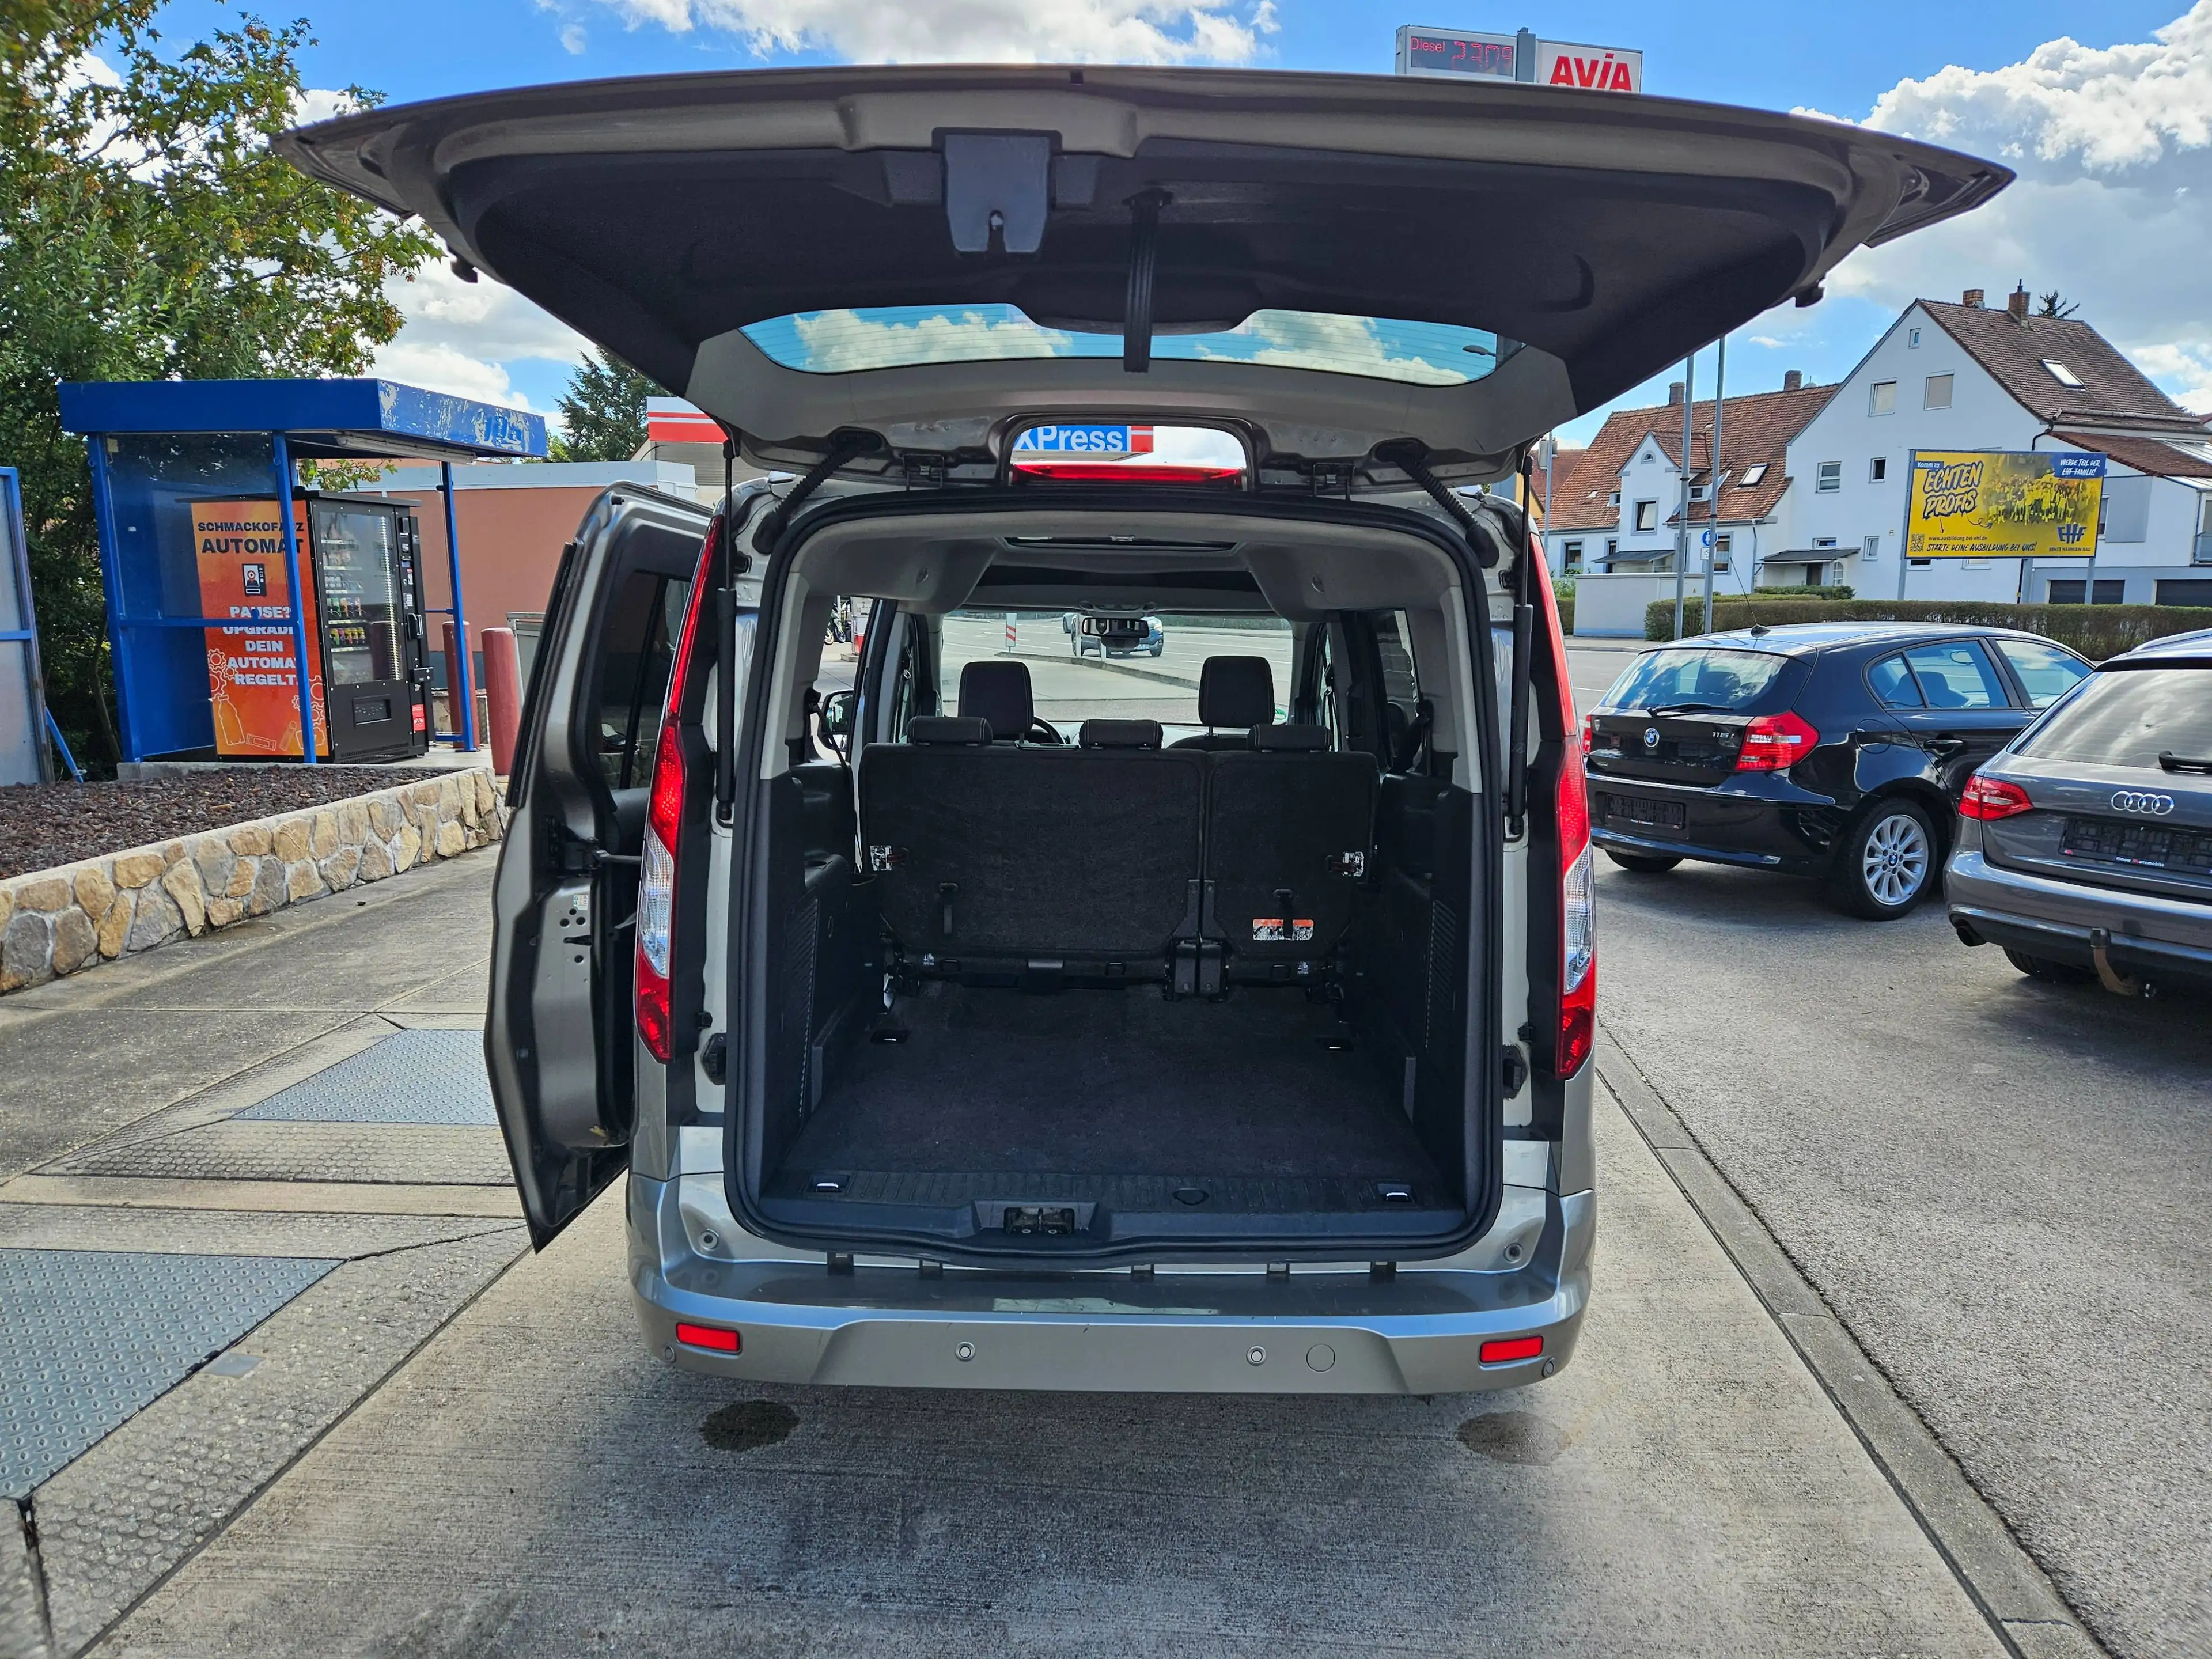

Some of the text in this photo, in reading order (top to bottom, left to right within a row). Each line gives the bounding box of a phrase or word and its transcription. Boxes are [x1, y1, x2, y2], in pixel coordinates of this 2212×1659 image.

[1411, 37, 1445, 52] Diesel
[2078, 459, 2089, 467] TEIL
[1923, 460, 1984, 494] ECHTEN
[1923, 488, 1978, 520] PROFIS
[198, 522, 304, 532] SCHMACKOFZ
[2057, 524, 2088, 544] EHF
[1927, 543, 1949, 551] STARTE
[1969, 543, 2009, 551] AUSBILDUNG
[2010, 543, 2020, 551] BEI
[2022, 541, 2038, 551] UNS!
[245, 640, 283, 652] DEIN
[228, 657, 296, 669] AUTOMA
